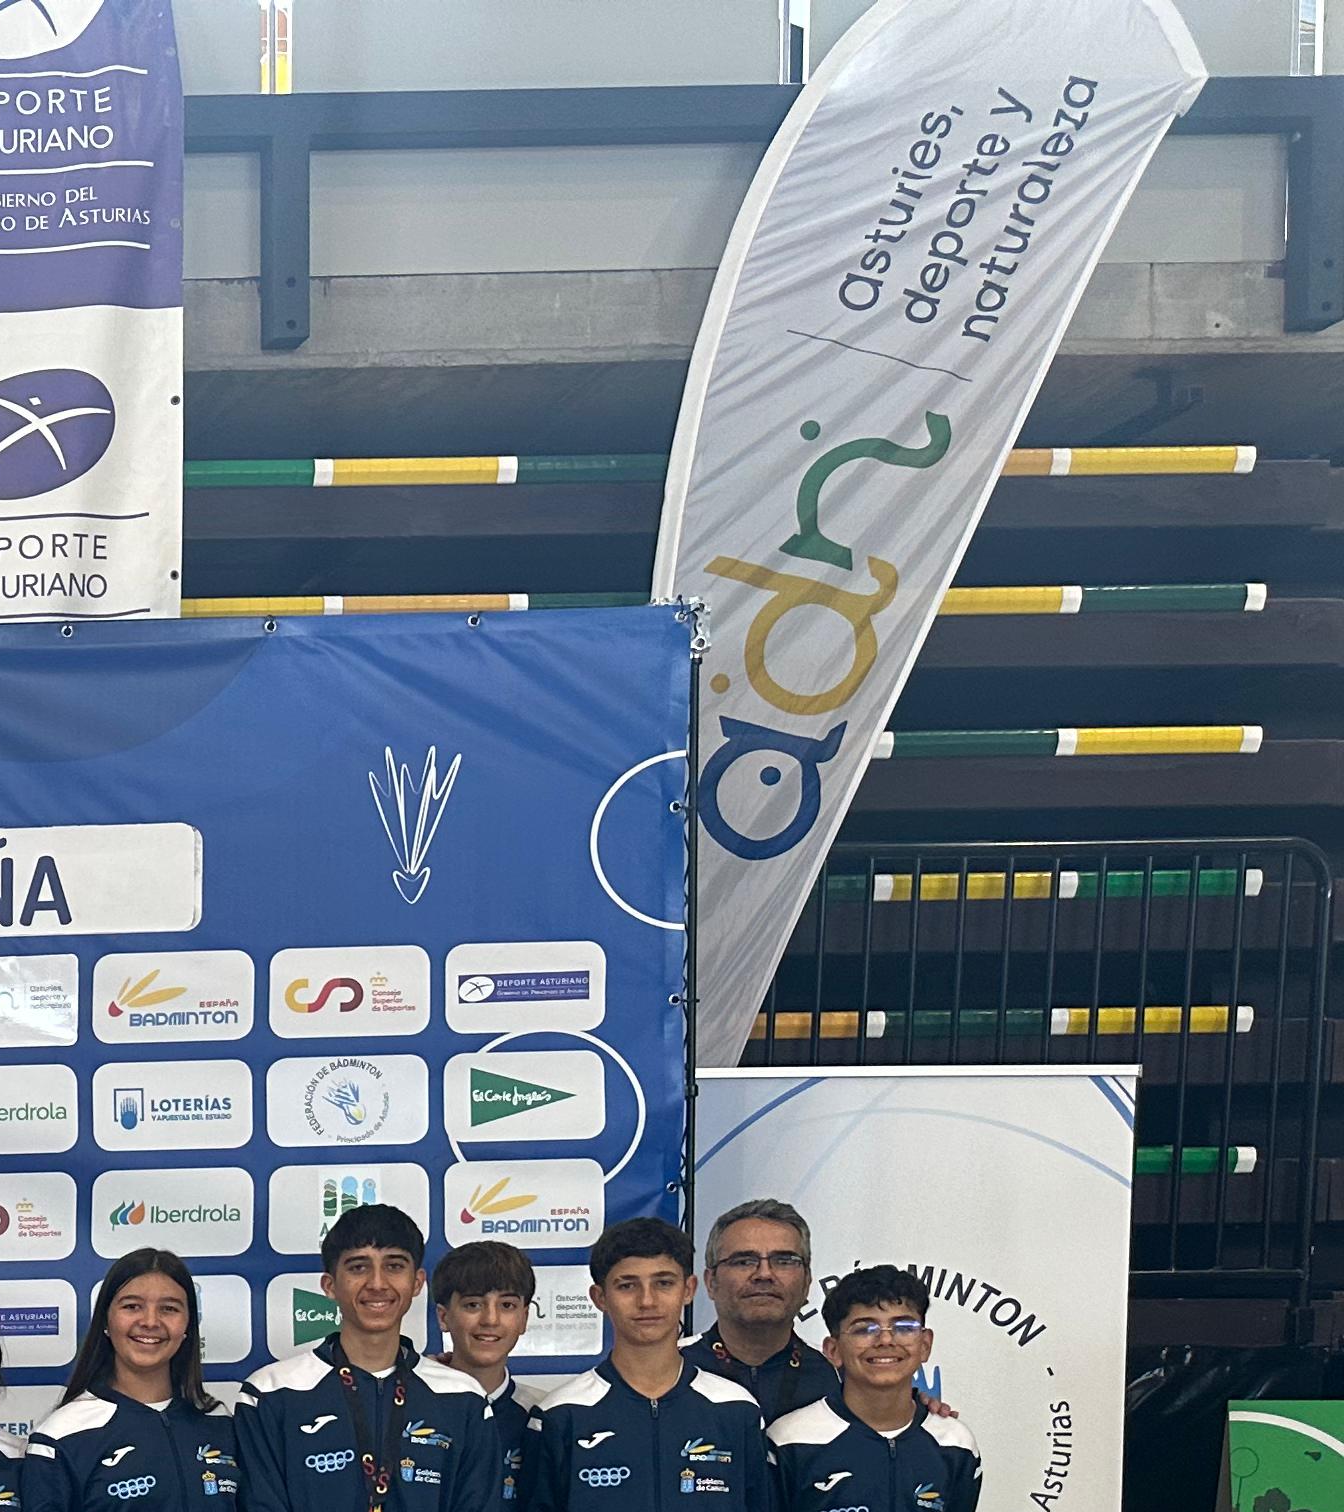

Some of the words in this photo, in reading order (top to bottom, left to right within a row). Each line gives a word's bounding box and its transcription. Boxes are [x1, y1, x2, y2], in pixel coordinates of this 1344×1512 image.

[838, 103, 962, 313] asturies,
[903, 131, 1010, 326] deporte
[998, 86, 1036, 123] y
[961, 75, 1098, 343] naturaleza
[497, 979, 536, 987] DEPORTE
[540, 977, 588, 986] ASTURIANO
[129, 1011, 238, 1027] BADMINTON
[316, 1067, 329, 1080] DE
[151, 1095, 231, 1112] LOTERÍAS
[484, 1091, 510, 1101] Corte
[150, 1204, 240, 1224] Iberdrola
[481, 1218, 589, 1233] BADMINTON
[8, 1312, 58, 1320] ASTURIANO
[1030, 1400, 1072, 1512] Asturias
